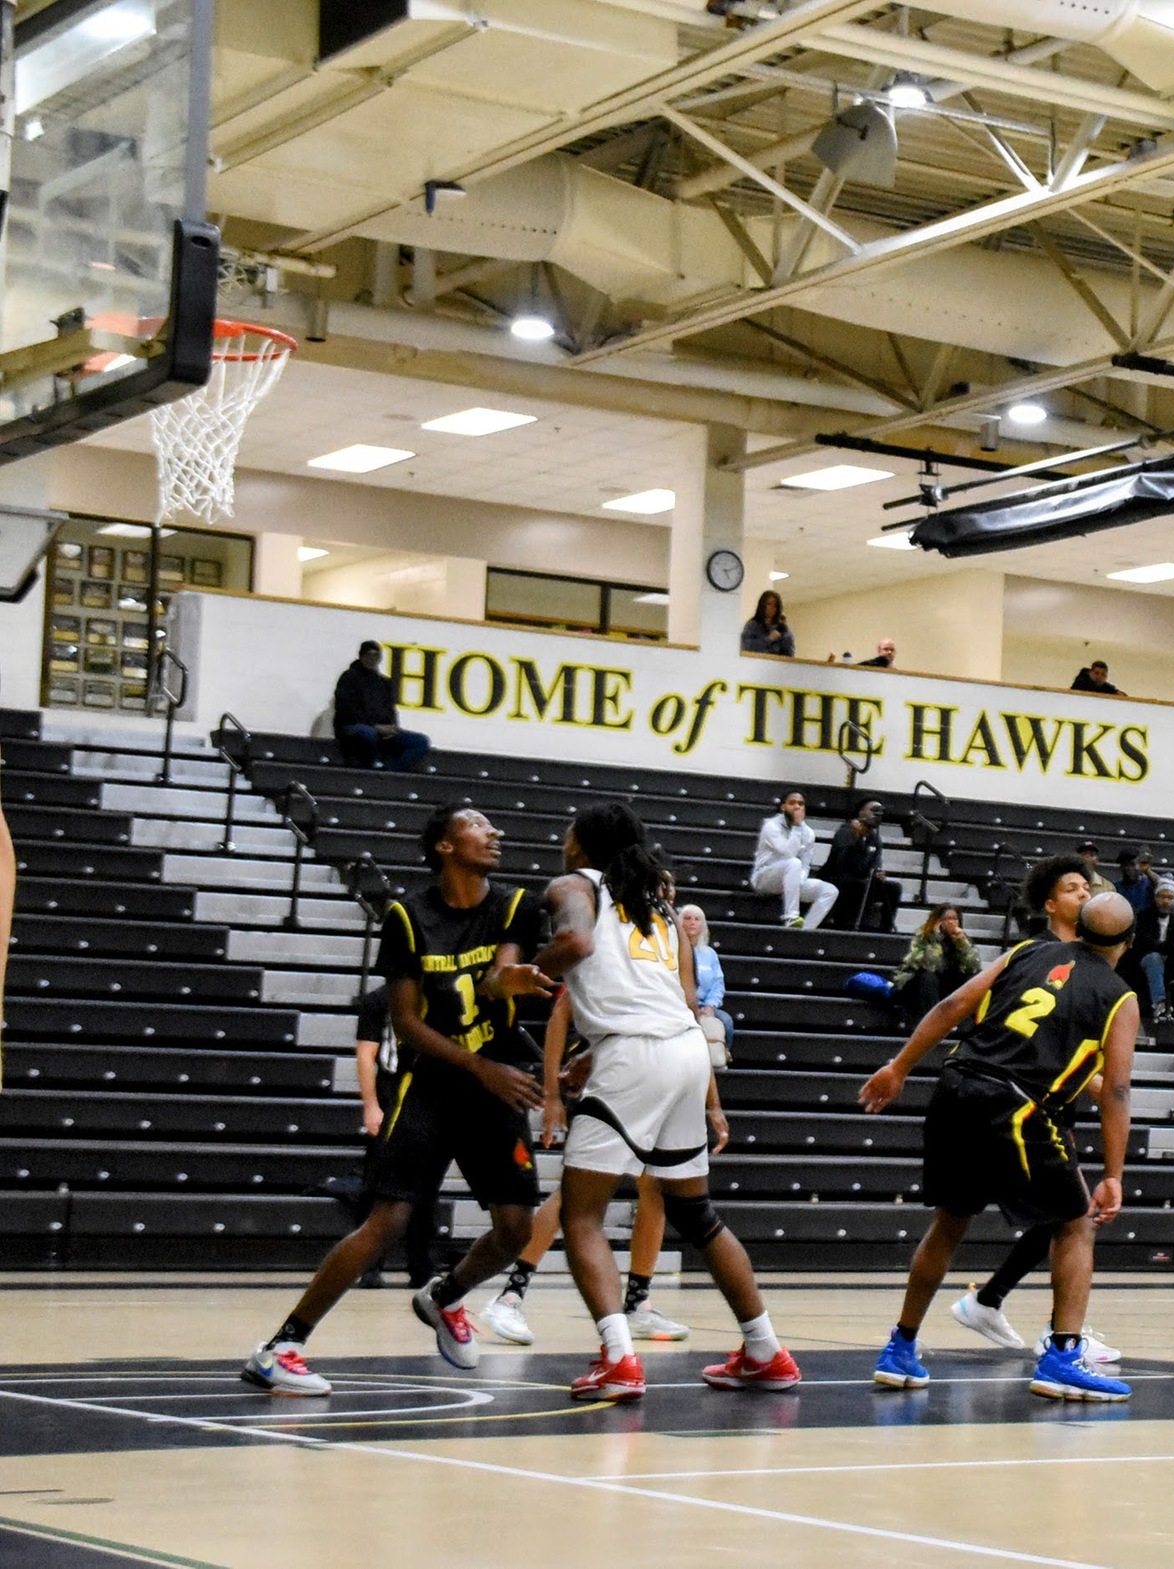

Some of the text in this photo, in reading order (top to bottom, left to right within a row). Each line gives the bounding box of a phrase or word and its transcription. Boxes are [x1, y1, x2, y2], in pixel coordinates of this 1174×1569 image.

[382, 642, 1151, 786] HOME of THE HAWKS
[454, 973, 479, 1026] 1
[1004, 987, 1056, 1038] 2
